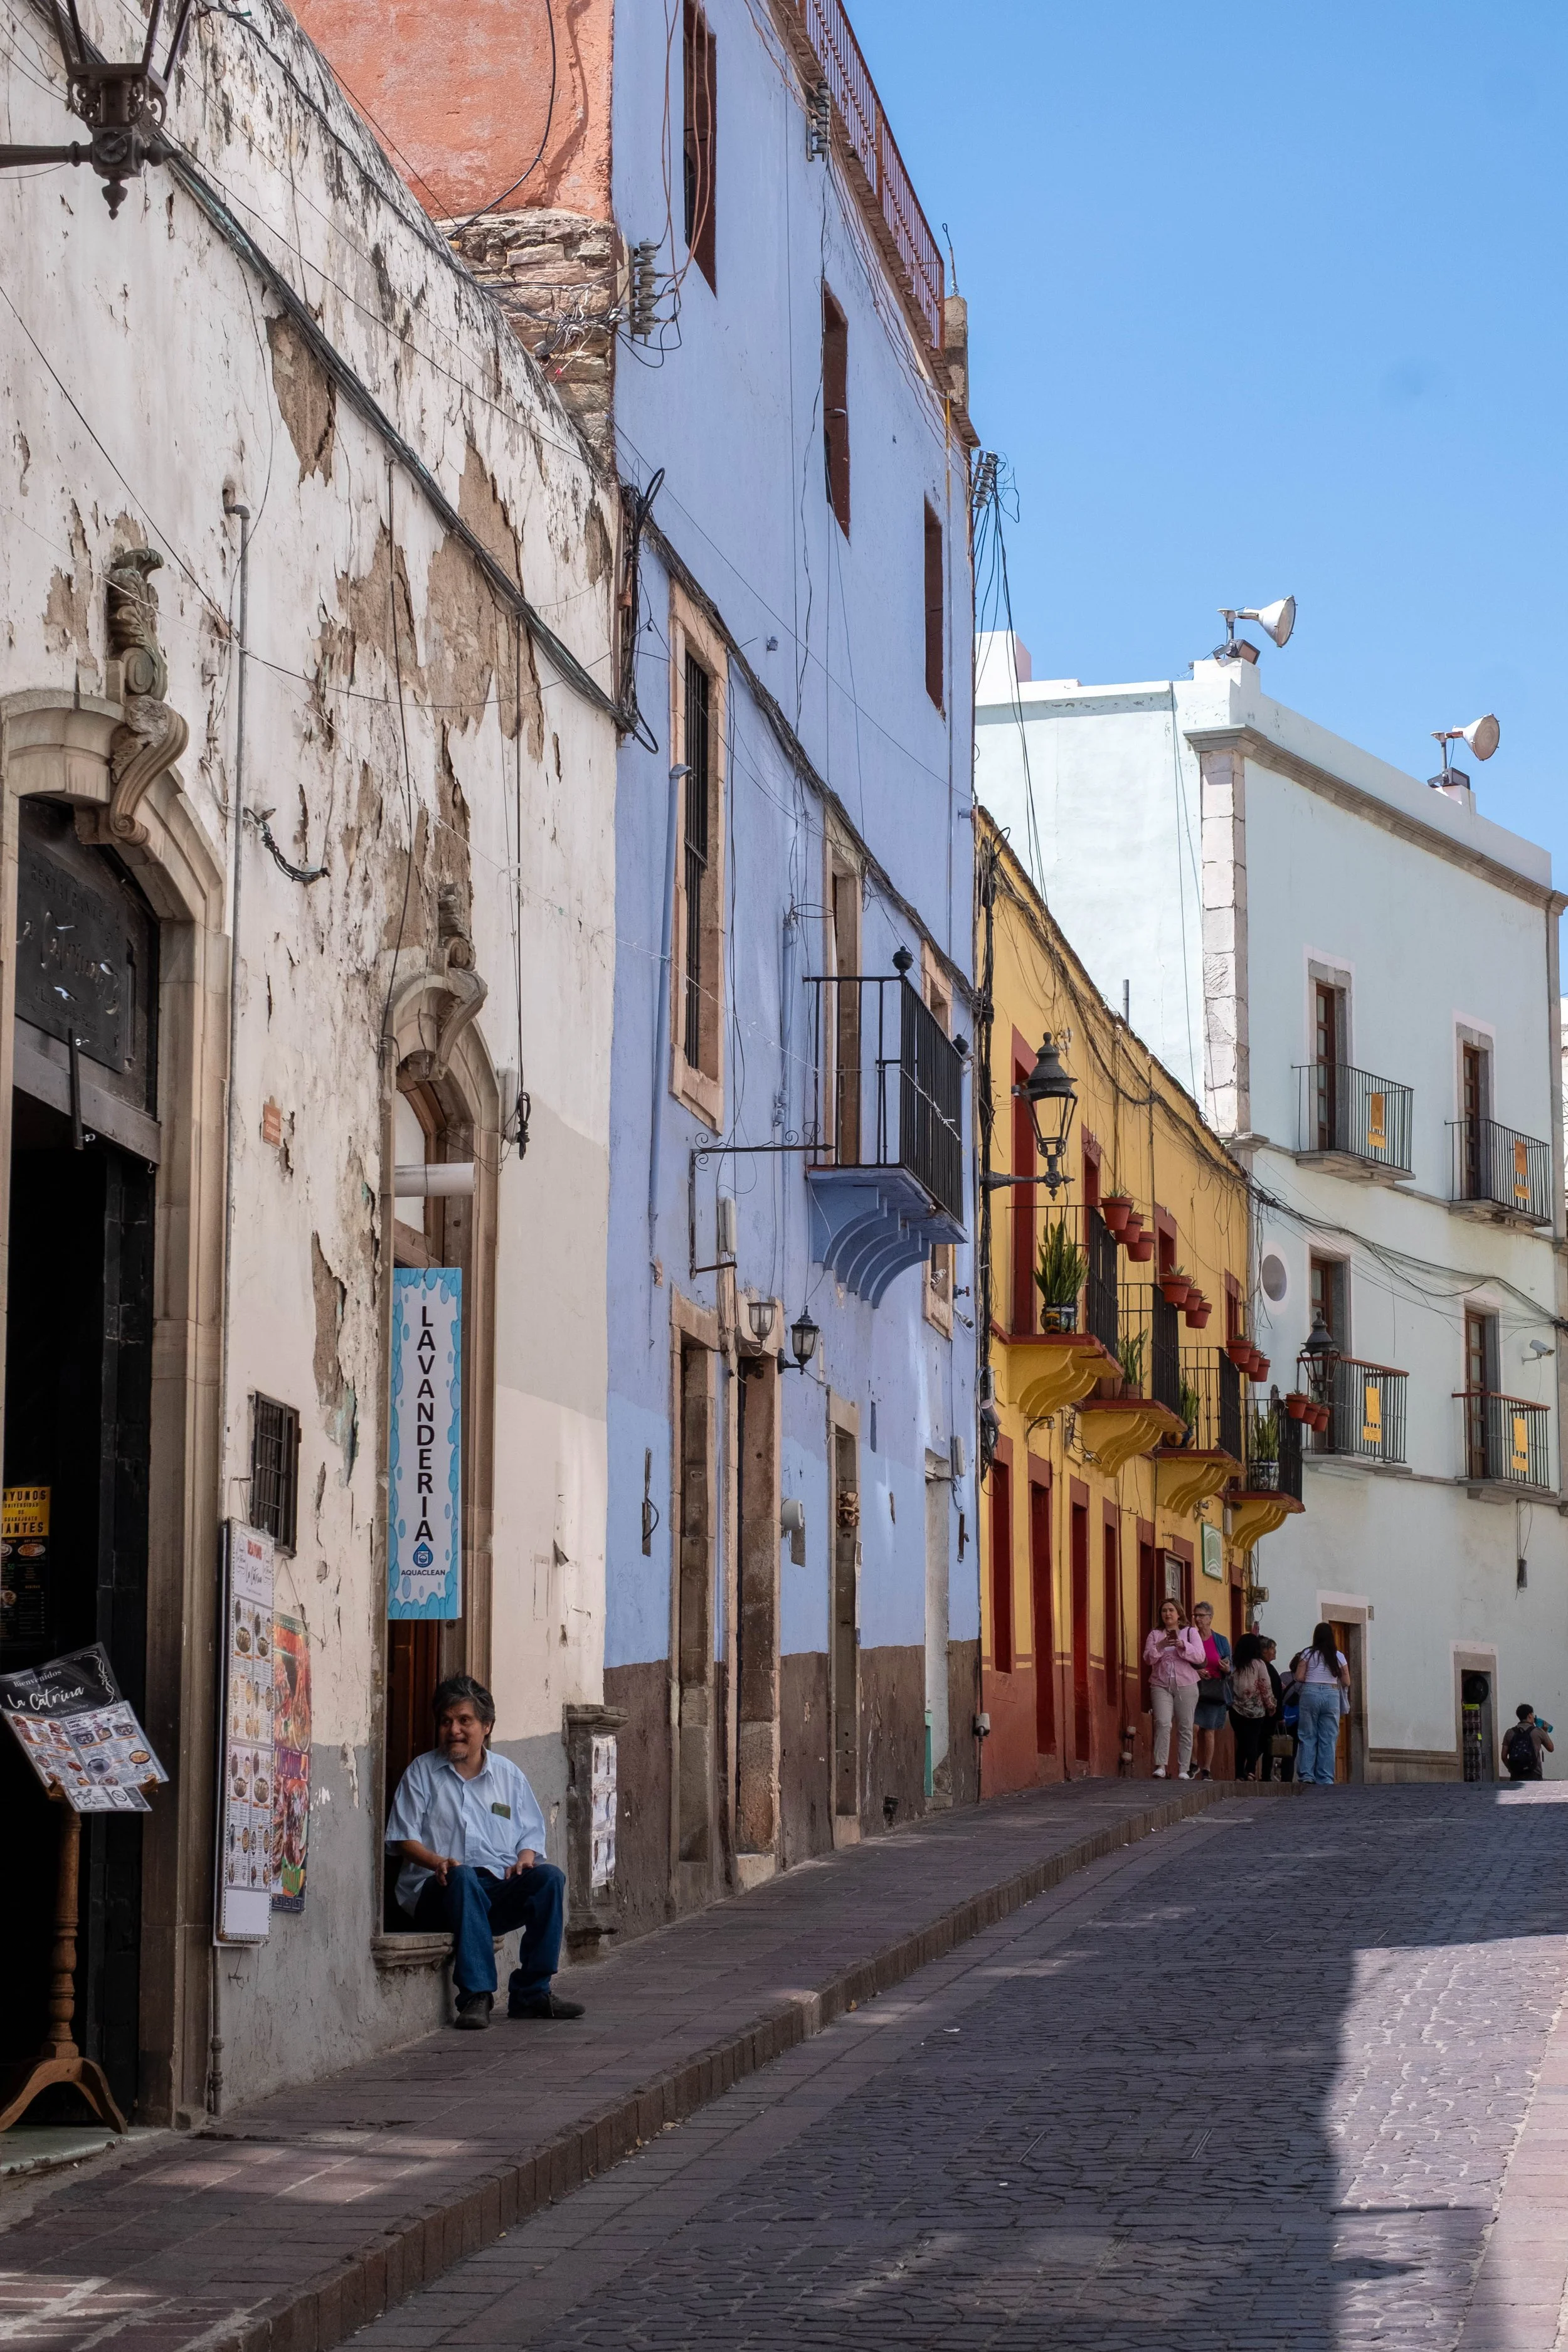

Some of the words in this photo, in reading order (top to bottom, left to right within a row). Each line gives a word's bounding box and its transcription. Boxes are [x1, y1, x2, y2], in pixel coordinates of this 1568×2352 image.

[31, 863, 103, 925] RESTAURANTE
[415, 1306, 435, 1542] LAVANDERIA
[7, 1694, 25, 1709] La
[29, 1686, 85, 1711] Catrina
